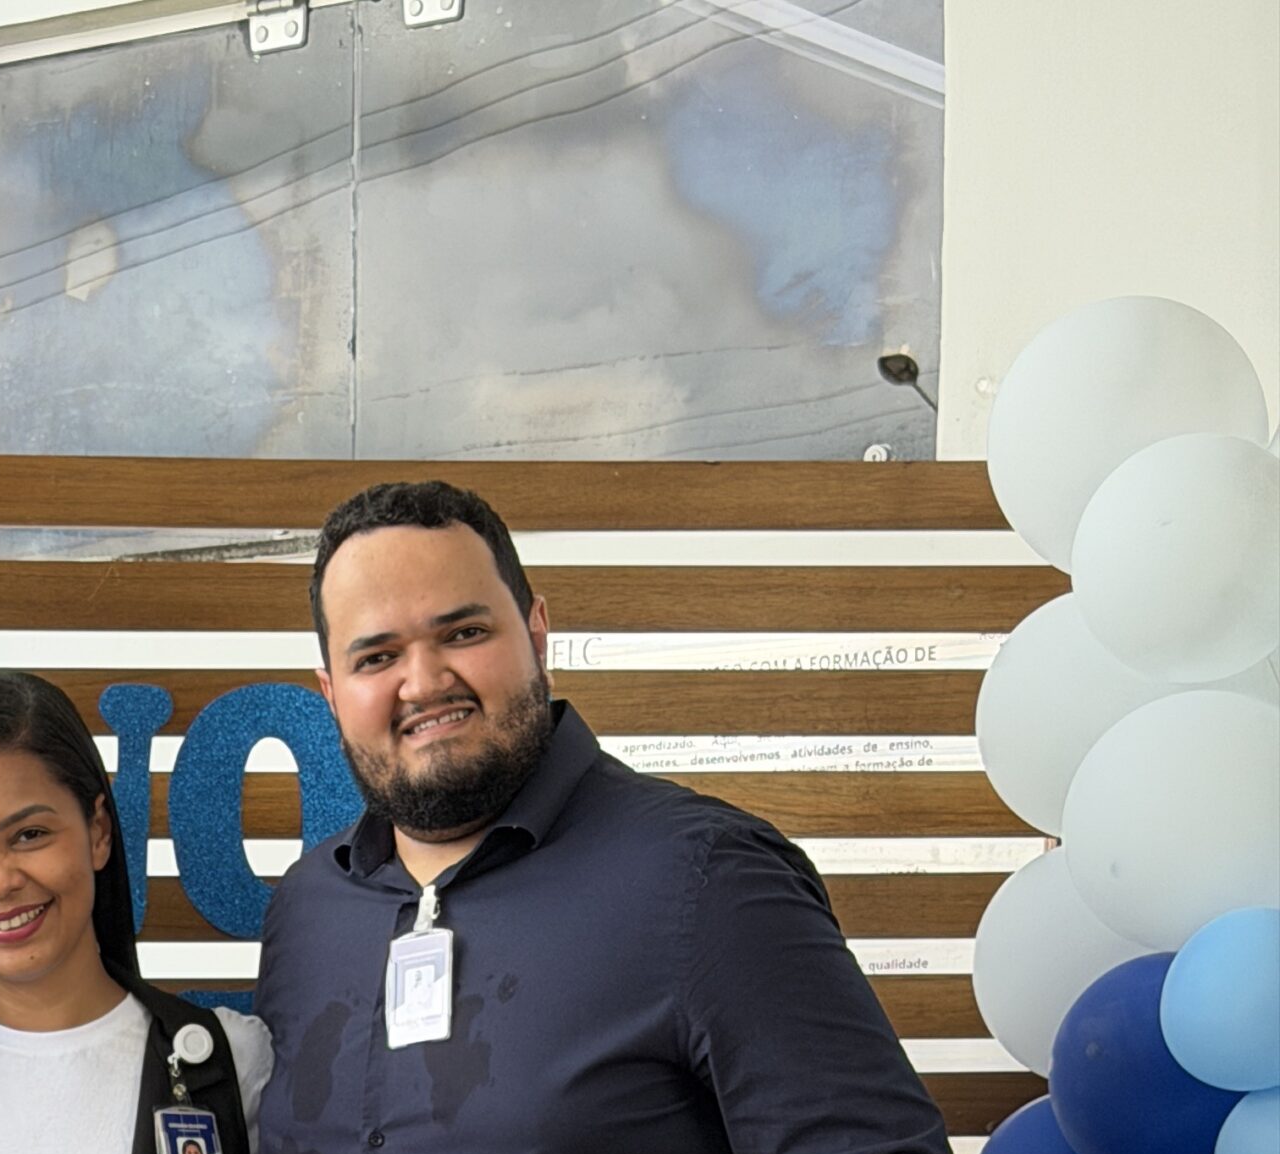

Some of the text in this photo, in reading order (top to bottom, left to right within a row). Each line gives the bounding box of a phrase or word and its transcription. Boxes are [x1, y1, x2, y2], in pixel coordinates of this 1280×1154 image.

[810, 645, 908, 669] FORMAÇÃO
[914, 645, 937, 662] DE
[689, 750, 781, 766] desenvolvemos
[791, 744, 853, 759] atividades
[863, 742, 878, 753] de
[855, 757, 913, 772] formação
[917, 756, 933, 767] de
[868, 957, 928, 972] qualidade
